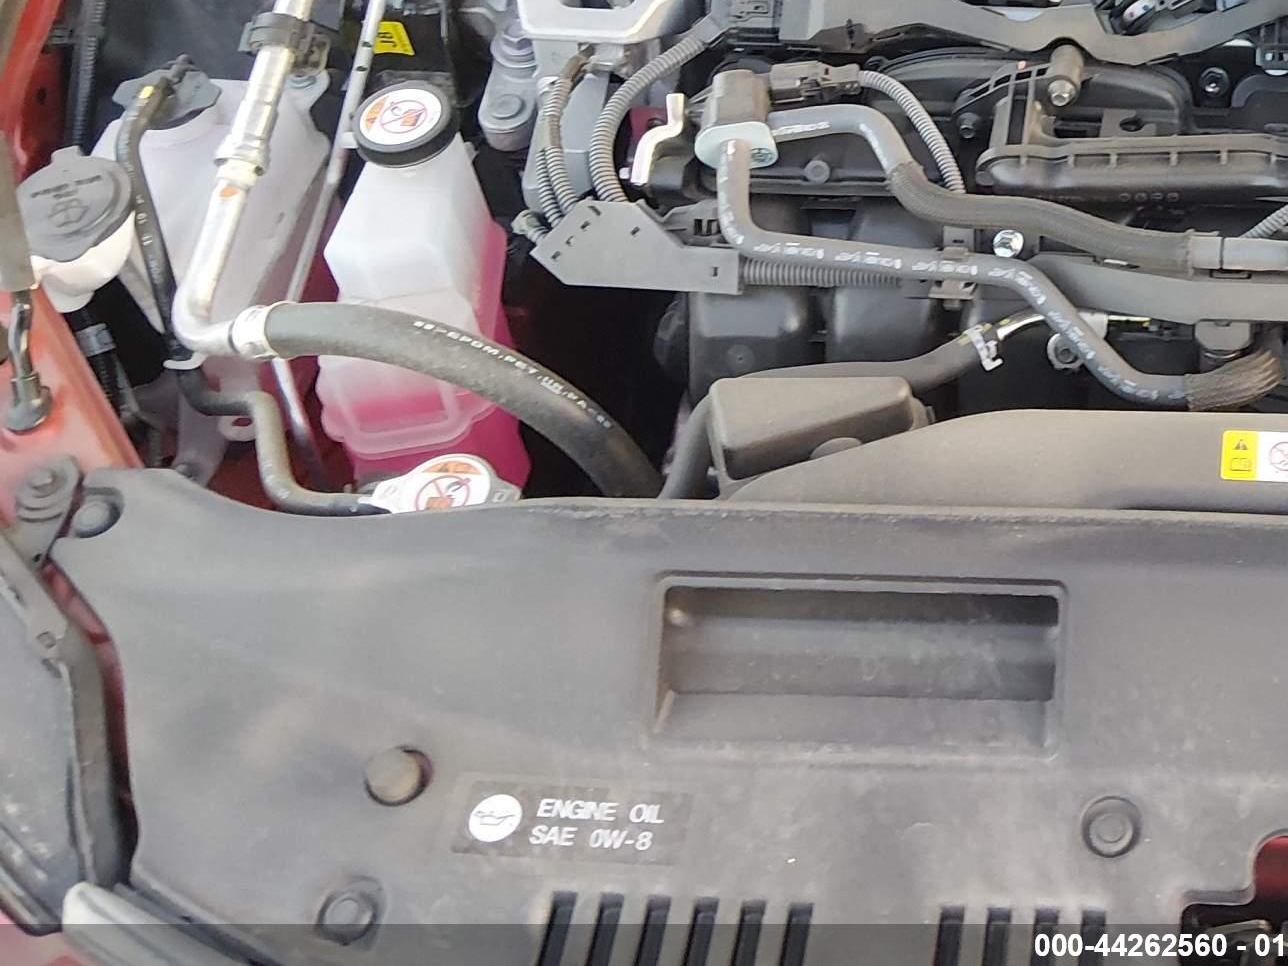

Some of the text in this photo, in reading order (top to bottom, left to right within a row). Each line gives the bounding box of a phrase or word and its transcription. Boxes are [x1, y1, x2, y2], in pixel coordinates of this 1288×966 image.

[536, 798, 665, 824] ENGINE OIL
[528, 824, 654, 851] SAE 0W-8
